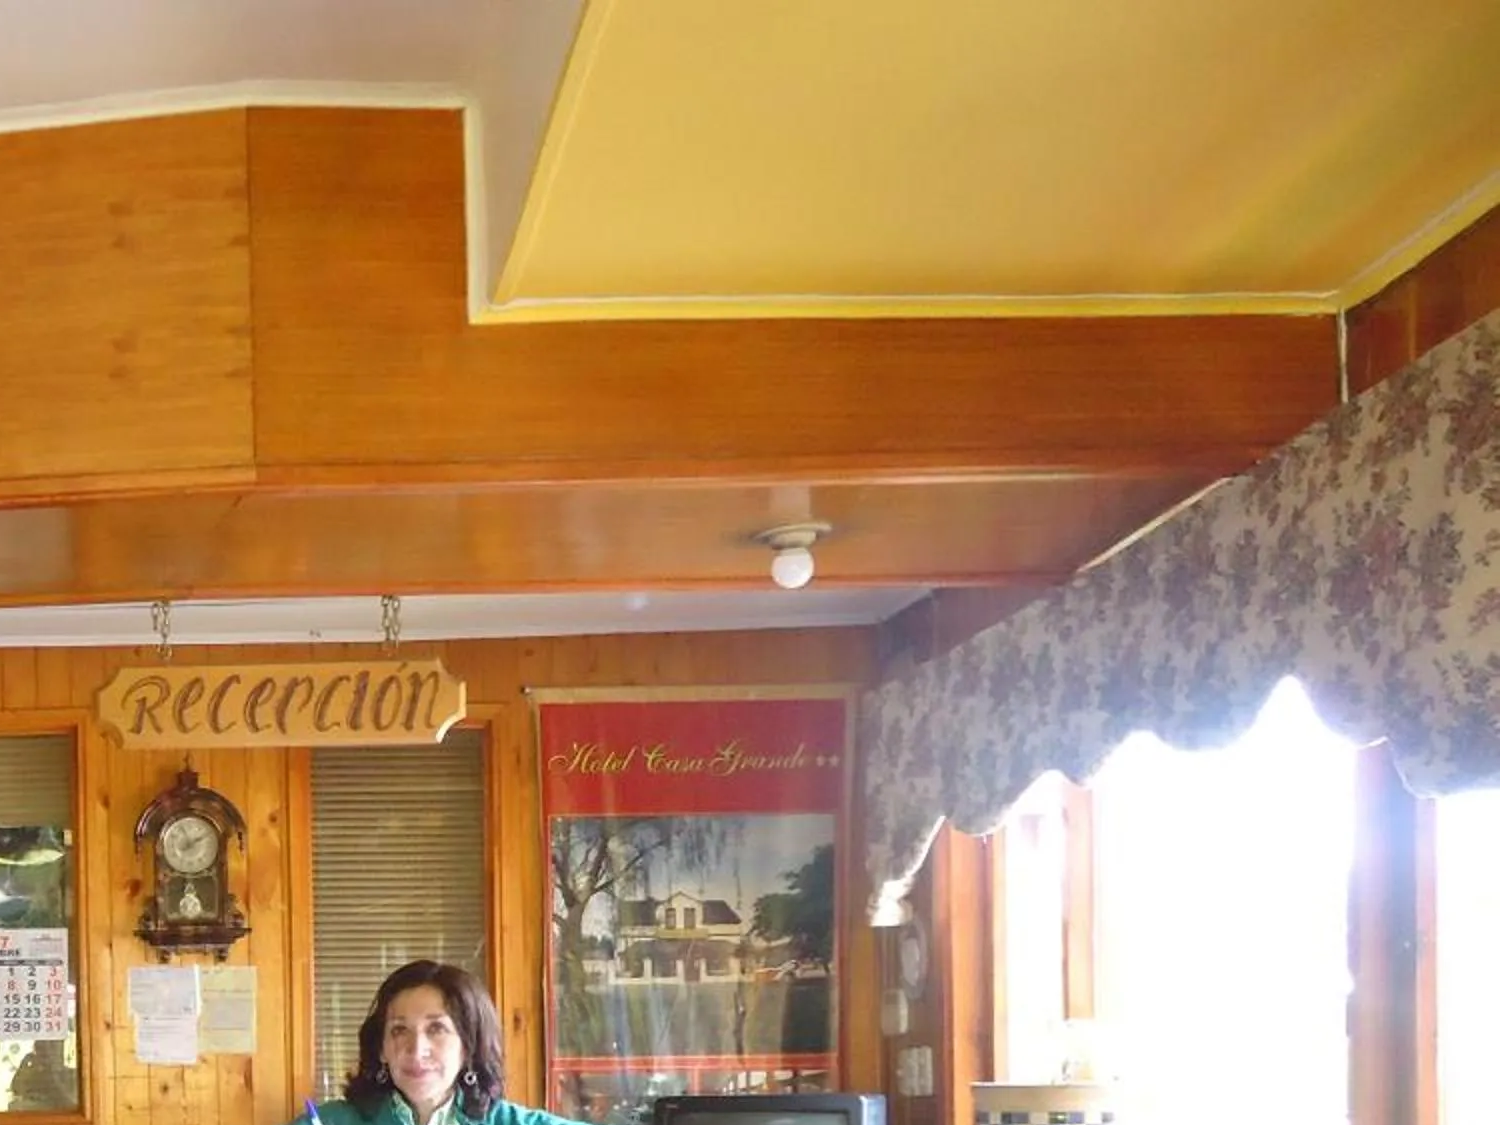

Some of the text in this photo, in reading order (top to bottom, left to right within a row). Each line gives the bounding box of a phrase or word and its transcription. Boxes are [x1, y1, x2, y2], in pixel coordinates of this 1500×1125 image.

[547, 738, 809, 776] Hotel Casa Grande
[46, 980, 61, 989] 10
[4, 994, 20, 1004] 15
[25, 994, 41, 1004] 16
[46, 994, 61, 1003] 17
[3, 1008, 21, 1018] 22
[24, 1008, 41, 1018] 23
[45, 1008, 62, 1018] 24
[3, 1022, 21, 1032] 29
[23, 1022, 41, 1032] 30
[45, 1021, 61, 1032] 31
